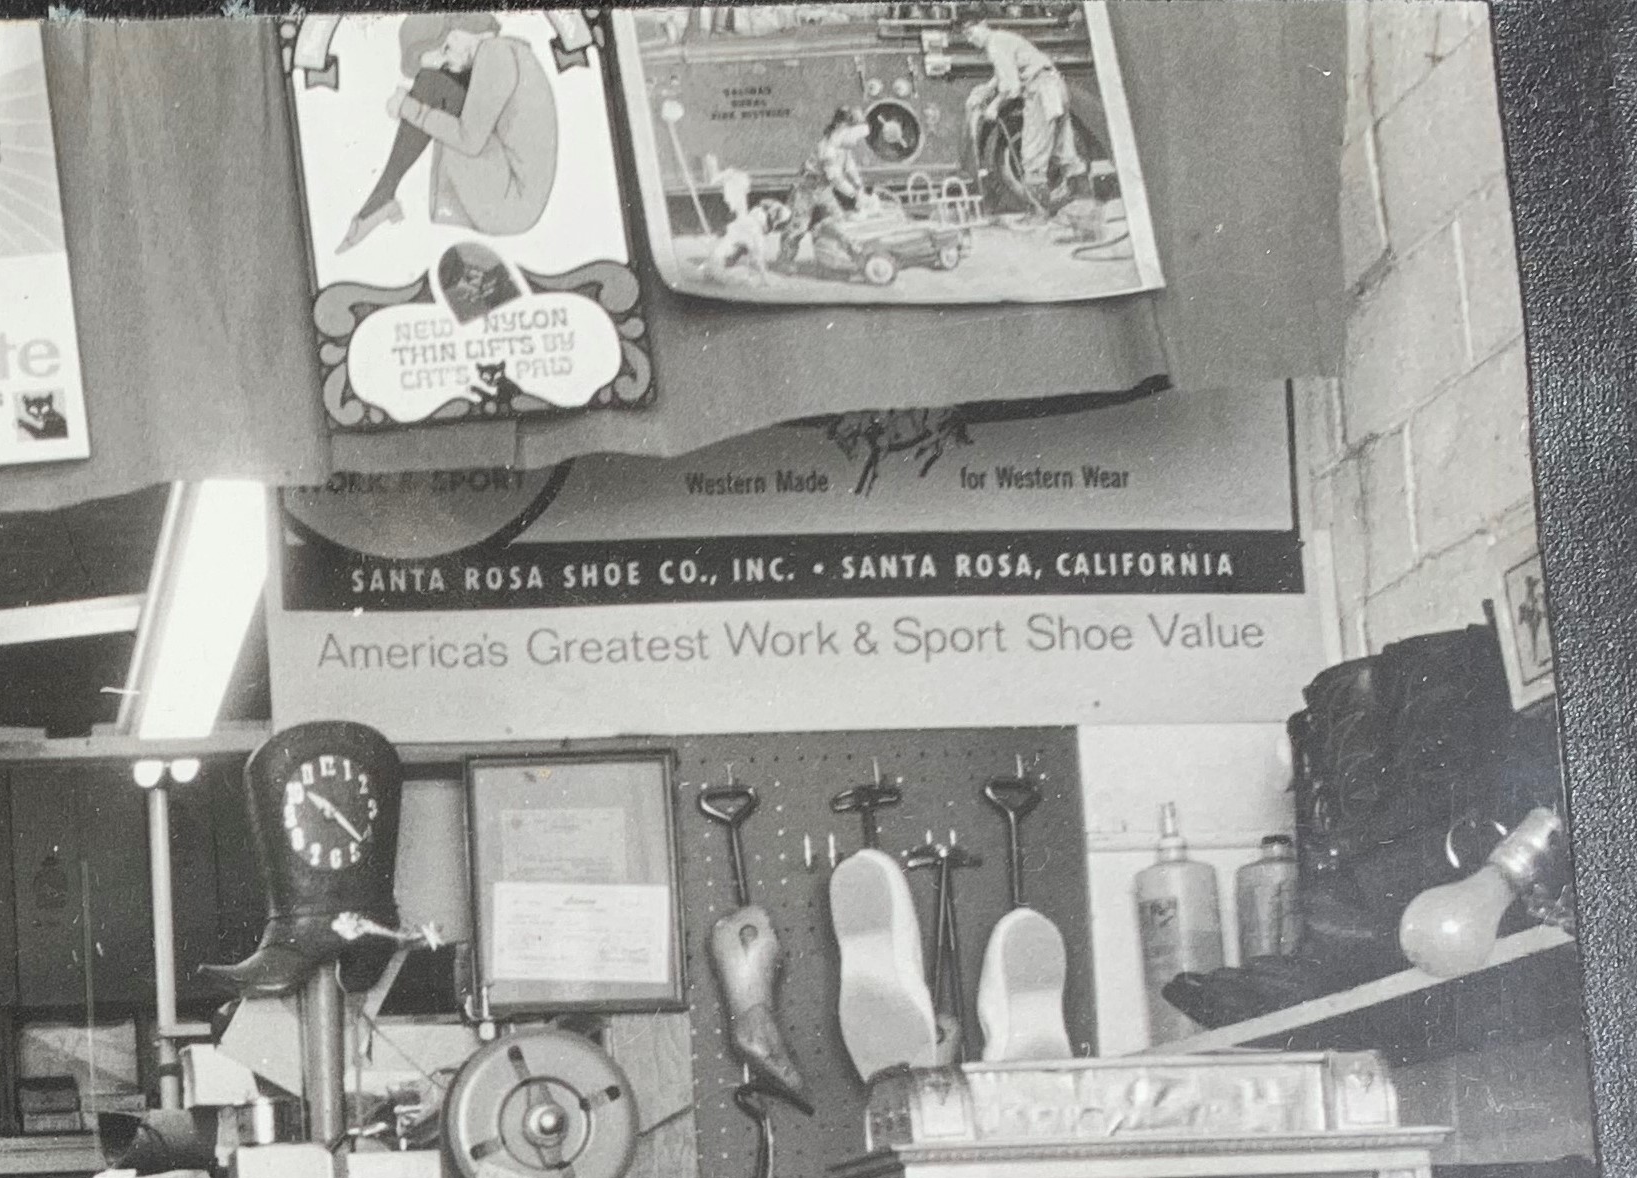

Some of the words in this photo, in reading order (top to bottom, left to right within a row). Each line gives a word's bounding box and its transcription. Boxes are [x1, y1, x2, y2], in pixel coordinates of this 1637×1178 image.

[394, 319, 453, 342] NEW
[483, 307, 568, 334] NYLON
[391, 342, 456, 366] THIN
[466, 335, 534, 360] LIFTS
[541, 331, 575, 353] BY
[400, 365, 470, 390] CAT'S
[516, 356, 573, 379] PAW
[684, 471, 766, 497] Western
[776, 469, 830, 494] Made
[960, 465, 987, 491] for
[994, 465, 1074, 490] Western
[1081, 464, 1130, 489] Wear
[351, 568, 445, 594] SANTA
[465, 565, 544, 590] ROSA
[563, 562, 642, 589] SHOE
[659, 559, 718, 587] CO.,
[733, 556, 794, 583] INC.
[841, 554, 938, 580] SANTA
[956, 553, 1042, 581] ROSA,
[1056, 552, 1234, 578] CALIFORNIA
[318, 632, 508, 670] America's
[526, 627, 710, 664] Greatest
[723, 620, 839, 658] Work
[853, 621, 878, 656] &
[894, 616, 1007, 662] Sport
[1026, 612, 1133, 651] Shoe
[1148, 612, 1265, 649] Value
